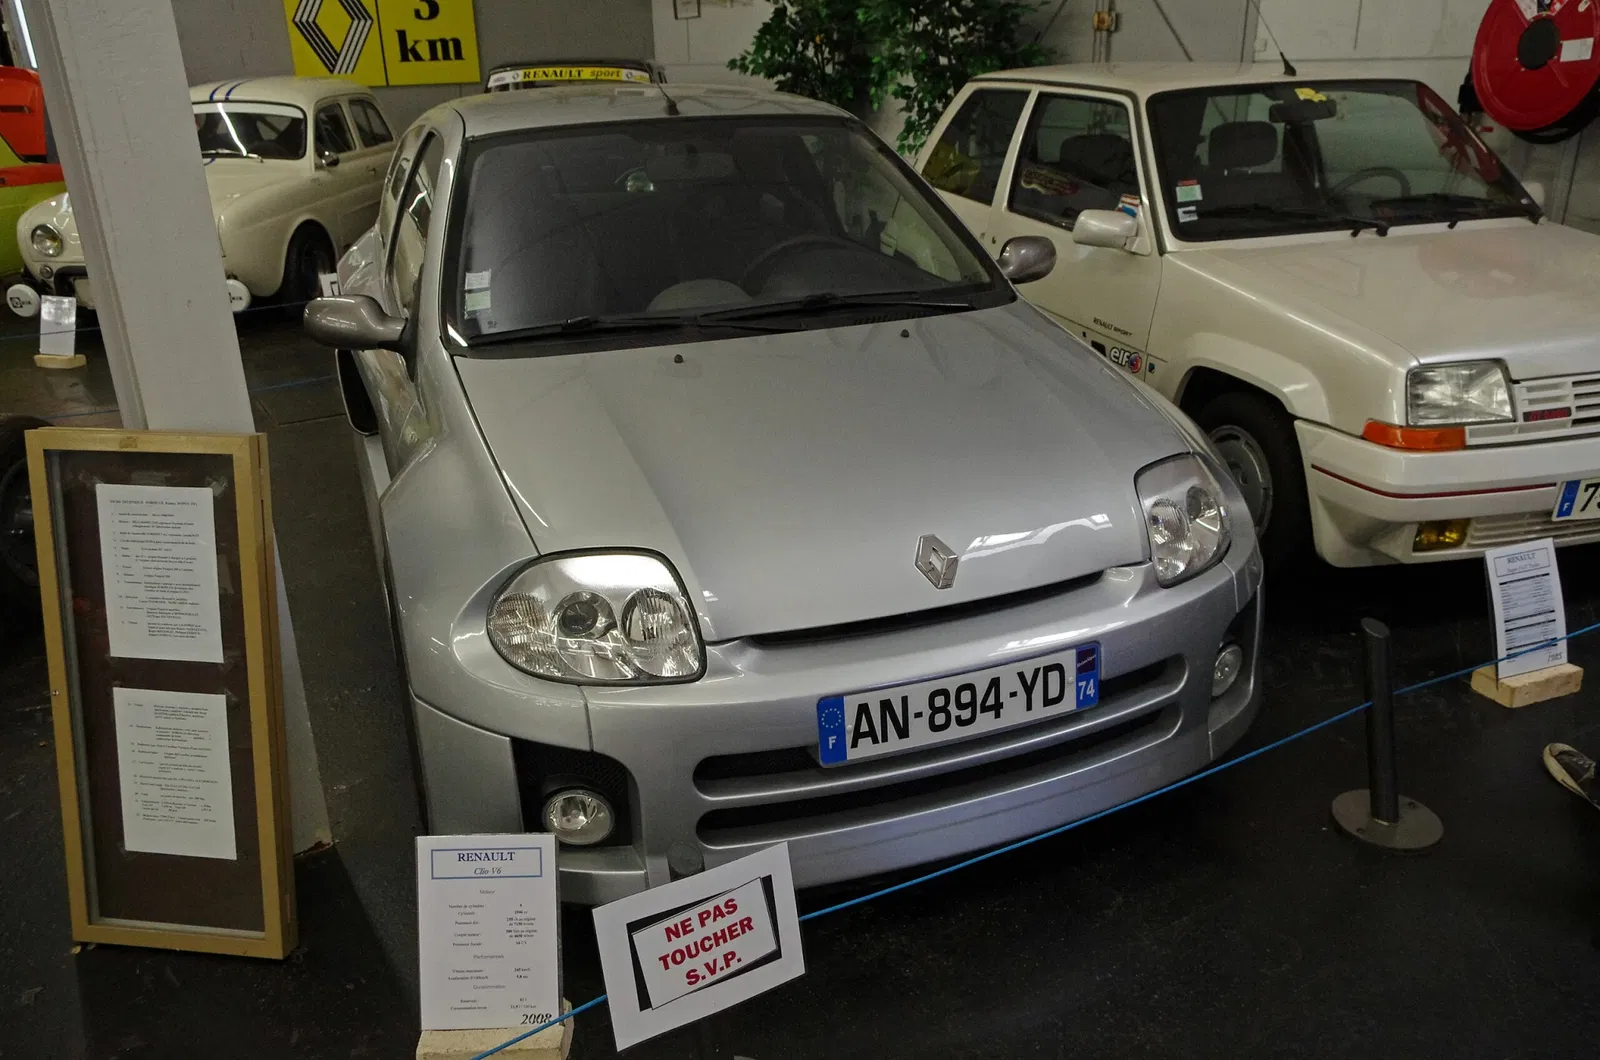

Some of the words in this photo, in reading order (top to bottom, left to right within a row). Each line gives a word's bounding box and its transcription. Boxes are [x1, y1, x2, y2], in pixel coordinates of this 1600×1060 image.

[395, 29, 465, 62] km
[523, 69, 584, 80] RENAULT
[589, 69, 620, 80] sport
[1109, 346, 1131, 366] elf
[1563, 503, 1571, 512] F
[1507, 553, 1537, 565] RENAULT
[1078, 678, 1095, 701] 74
[850, 662, 1066, 750] AN-894-YD
[828, 735, 837, 750] F
[457, 851, 516, 862] RENAULT
[473, 867, 489, 876] Clio
[491, 867, 502, 875] V6
[664, 916, 695, 943] NE
[697, 898, 738, 928] PAS
[658, 916, 755, 971] TOUCHER
[685, 950, 742, 986] S.V.P.
[520, 1012, 552, 1026] 2008
